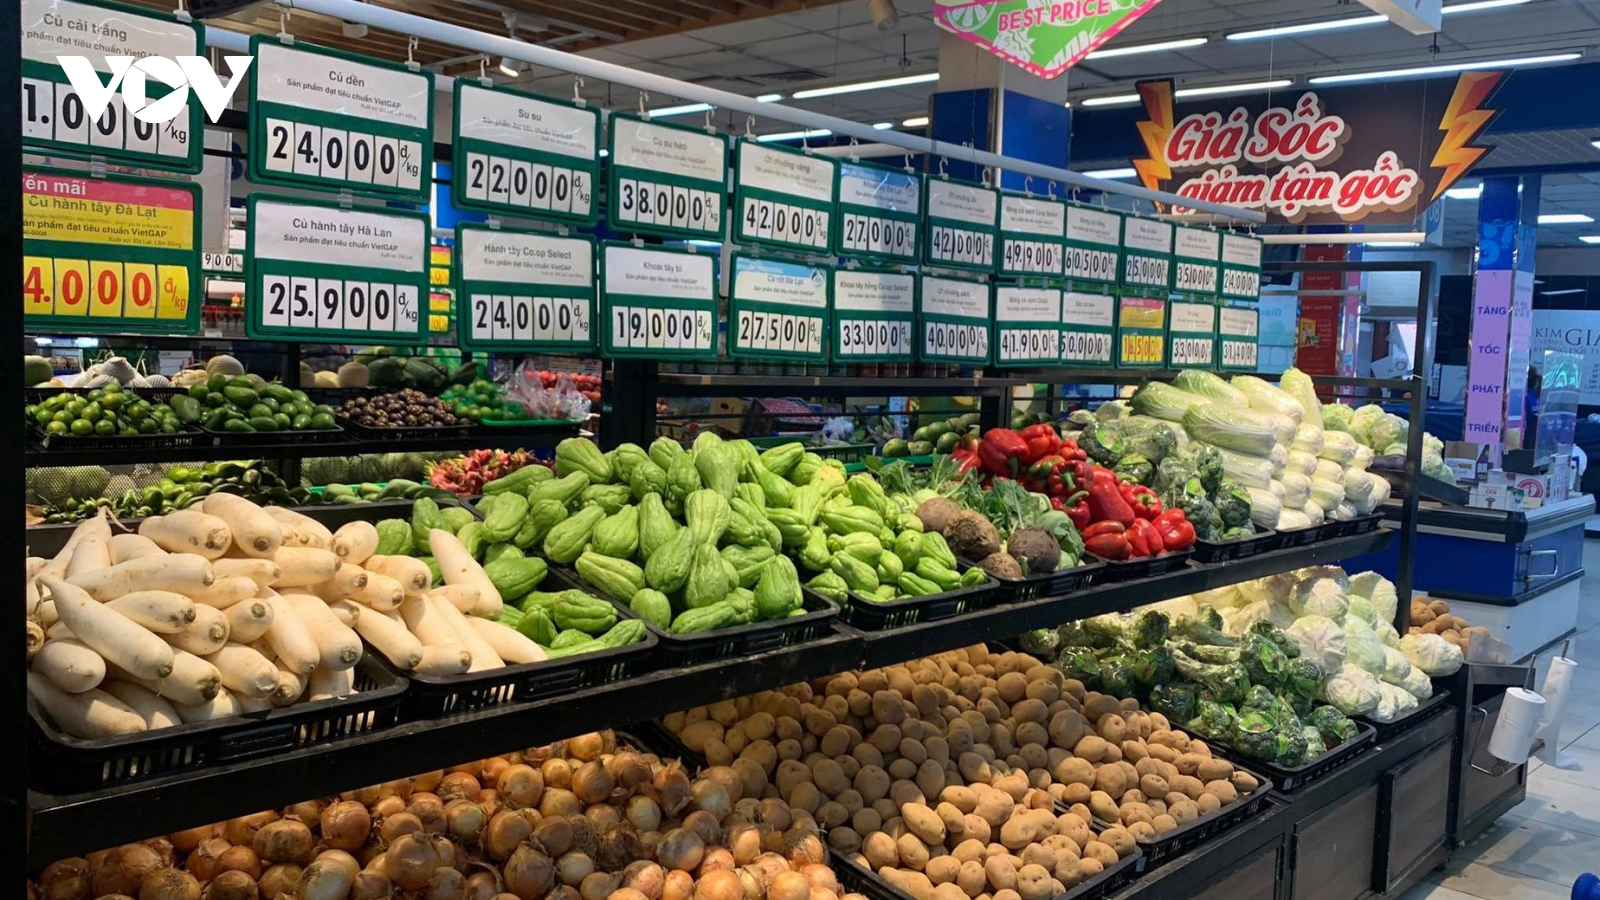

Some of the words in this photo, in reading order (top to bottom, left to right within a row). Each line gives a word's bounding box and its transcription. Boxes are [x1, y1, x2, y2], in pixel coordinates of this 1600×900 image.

[43, 13, 63, 27] Củ
[67, 18, 87, 32] cải
[997, 7, 1046, 32] BEST
[1050, 0, 1112, 24] PRICE
[56, 35, 72, 46] đạt
[74, 39, 91, 49] tiêu
[93, 42, 121, 54] chuẩn
[329, 70, 343, 82] Củ
[345, 73, 365, 87] dền
[287, 78, 301, 88] Sản
[303, 82, 323, 92] phẩm
[325, 87, 337, 96] đạt
[338, 89, 351, 98] tiêu
[352, 94, 373, 103] chuẩn
[374, 97, 401, 109] VietGAP
[518, 109, 530, 119] Su
[531, 113, 542, 121] su
[1167, 110, 1246, 163] Giá
[1249, 96, 1339, 156] Sốc
[272, 126, 395, 174] 24.000
[54, 180, 86, 195] mãi
[471, 159, 568, 201] 22.000
[1270, 168, 1334, 211] tận
[1338, 157, 1411, 207] gốc
[53, 198, 87, 211] hành
[91, 202, 111, 216] tây
[115, 204, 133, 215] Đà
[137, 206, 157, 220] Lạt
[623, 184, 702, 221] 38.000
[293, 218, 308, 229] Củ
[310, 220, 337, 233] hành
[339, 223, 355, 236] tây
[358, 225, 371, 236] Hà
[374, 227, 392, 238] Lan
[746, 204, 814, 237] 42.000
[102, 226, 130, 235] chuẩn
[131, 228, 167, 238] VietGAP
[283, 234, 298, 242] Sản
[300, 235, 320, 244] phẩm
[321, 238, 333, 247] đạt
[334, 239, 347, 247] tiêu
[348, 240, 370, 249] chuẩn
[371, 242, 398, 251] VietGAP
[846, 219, 904, 247] 27.000
[484, 244, 506, 253] Hành
[547, 249, 572, 260] Select
[934, 231, 982, 256] 42.000
[1006, 245, 1052, 266] 49.900
[1066, 251, 1108, 273] 60.500
[1127, 260, 1162, 279] 25.000
[1178, 266, 1210, 285] 35.000
[24, 266, 152, 307] 4.000
[1224, 273, 1252, 291] 24.000
[269, 282, 390, 320] 25.900
[476, 300, 570, 330] 24.000
[618, 312, 692, 339] 19.000
[741, 316, 806, 343] 27.500
[843, 324, 898, 346] 33.000
[928, 326, 976, 349] 40.000
[1535, 328, 1562, 338] KIM
[1002, 334, 1048, 352] 41.900
[1174, 341, 1205, 358] 33.000
[1472, 384, 1500, 394] PHÁT
